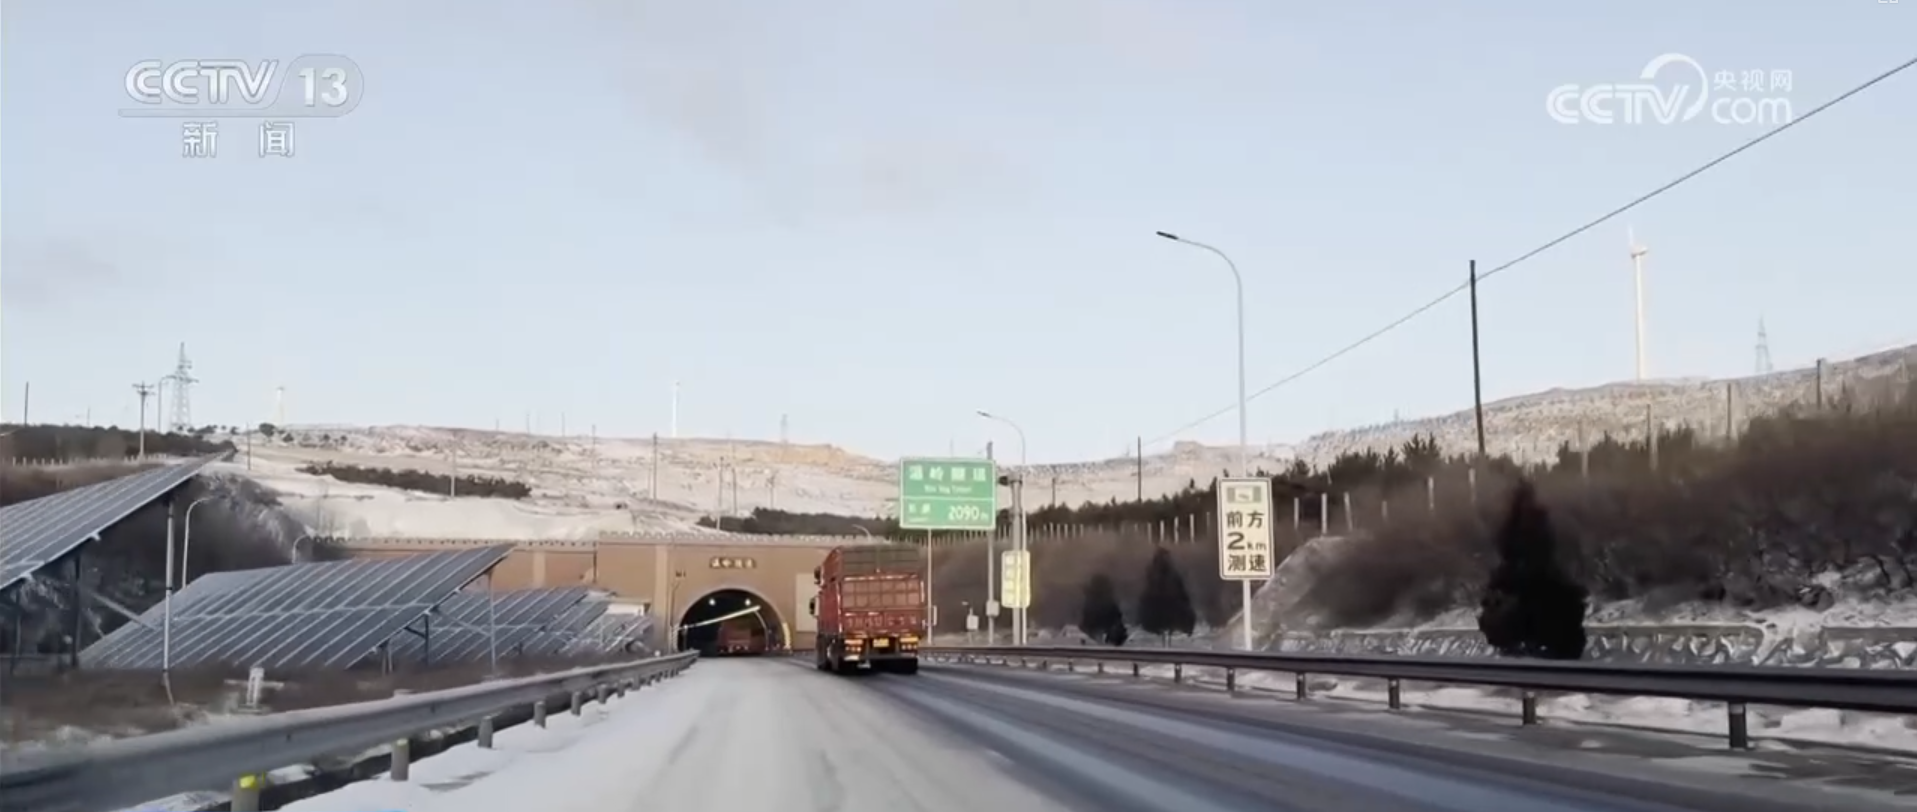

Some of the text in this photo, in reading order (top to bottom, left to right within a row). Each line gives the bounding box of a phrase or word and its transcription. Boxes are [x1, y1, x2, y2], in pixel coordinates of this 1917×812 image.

[1226, 510, 1264, 528] 前方
[1227, 531, 1267, 551] 2km
[1227, 554, 1267, 572] 测速
